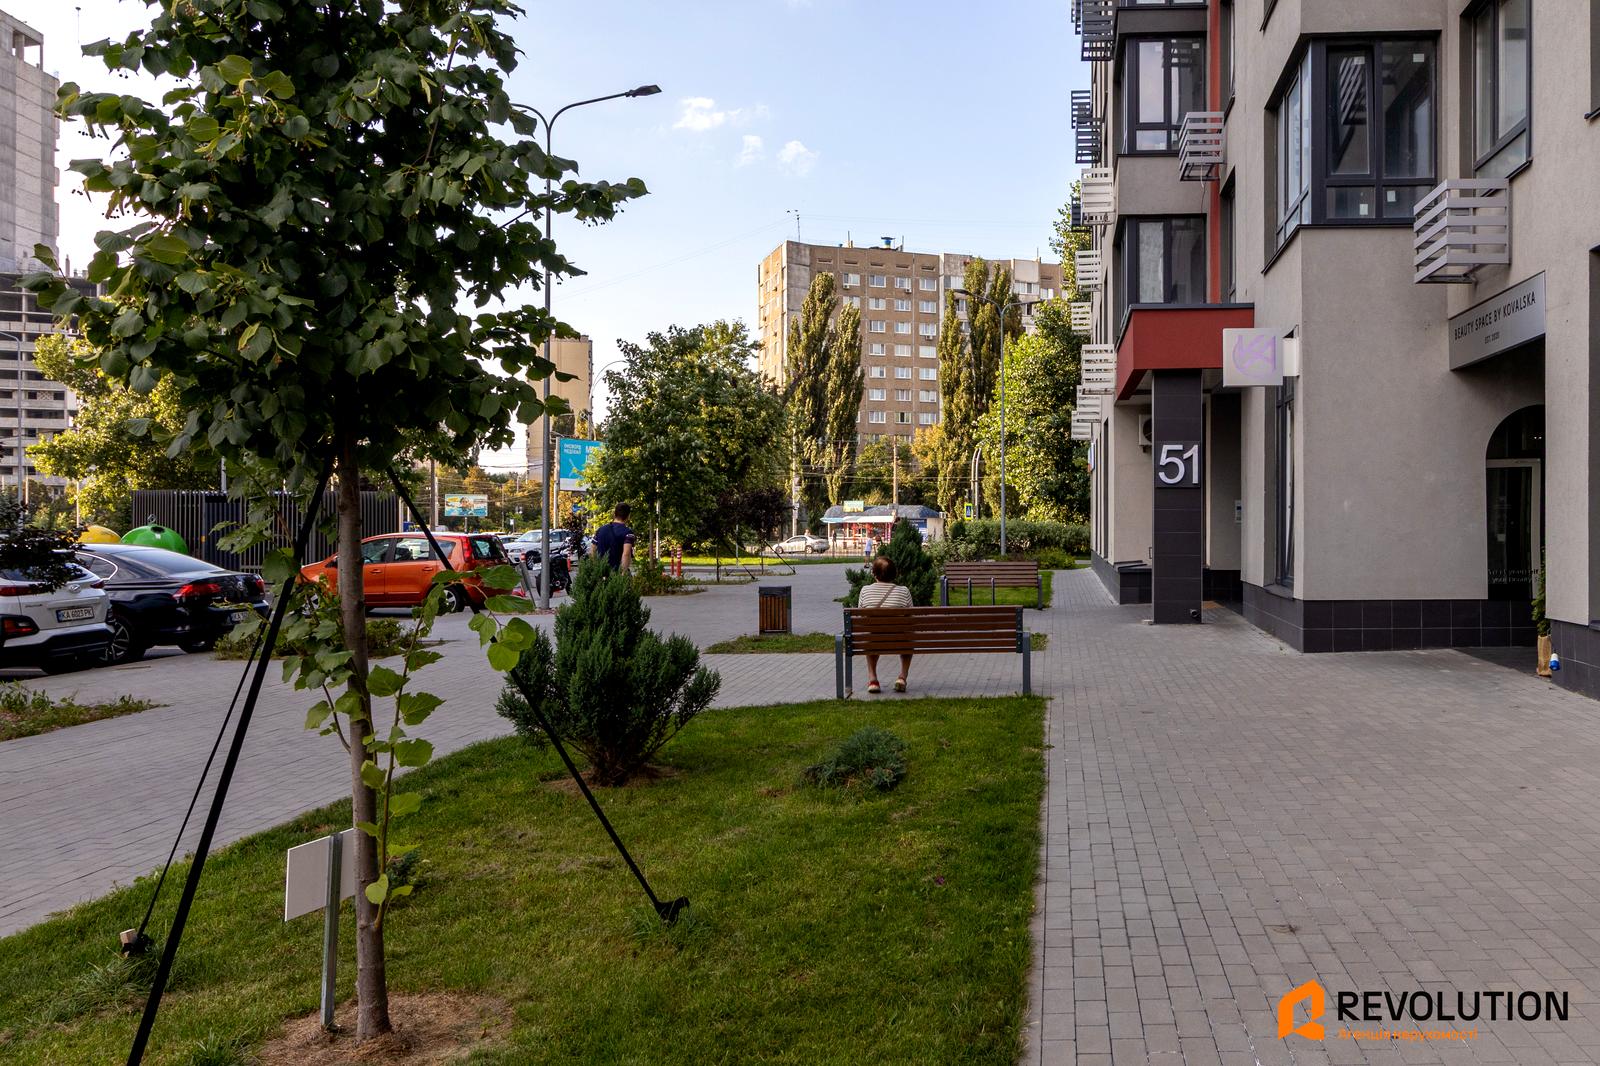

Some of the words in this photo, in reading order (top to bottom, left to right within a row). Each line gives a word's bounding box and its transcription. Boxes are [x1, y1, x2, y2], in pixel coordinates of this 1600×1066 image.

[1454, 324, 1475, 341] BEAUTY
[1475, 312, 1492, 331] SPACE
[1494, 307, 1502, 323] BY
[1503, 291, 1536, 318] KOVALSKA
[1158, 444, 1200, 485] 51
[62, 611, 71, 619] KA
